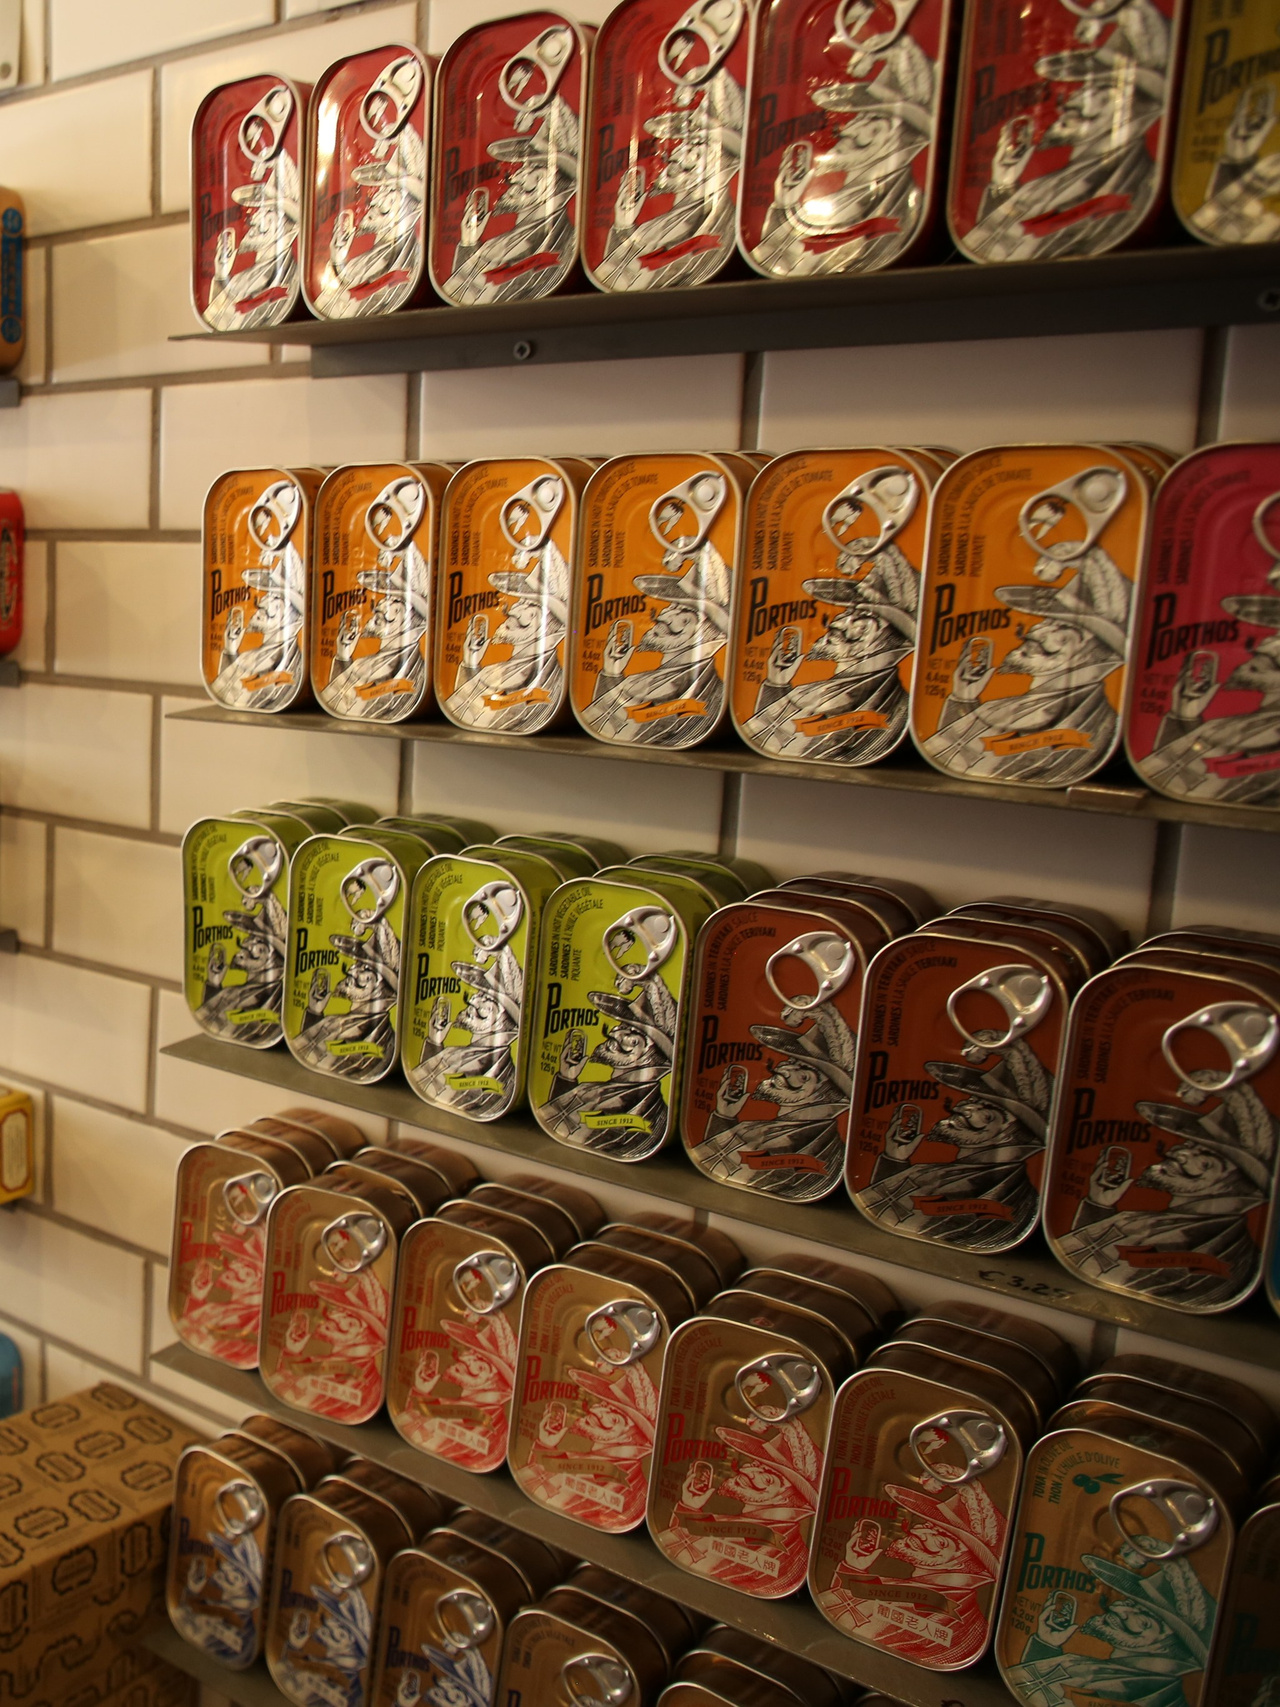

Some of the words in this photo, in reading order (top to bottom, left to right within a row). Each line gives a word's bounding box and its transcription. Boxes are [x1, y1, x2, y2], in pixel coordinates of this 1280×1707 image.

[211, 569, 250, 622] PORTHOS
[323, 570, 366, 626] PORTHOS
[449, 571, 498, 630] PORTHOS
[586, 573, 646, 636] PORTHOS
[748, 576, 817, 644] PORTHOS
[931, 583, 1011, 655] PORTHOS
[1147, 592, 1241, 670] PORTHOS
[192, 906, 233, 953] PORTHOS
[296, 928, 339, 977] PORTHOS
[549, 941, 559, 976] SARDINES
[556, 889, 582, 920] VEGETABLE
[581, 887, 592, 897] OIL
[416, 953, 460, 1005] PORTHOS
[571, 950, 581, 981] PIQUANTE
[544, 983, 599, 1038] PORTHOS
[699, 1016, 763, 1074] PORTHOS
[865, 1051, 940, 1114] PORTHOS
[1067, 1088, 1152, 1155] PORTHOS
[761, 1159, 784, 1167] SINCE
[937, 1205, 964, 1213] SINCE
[271, 1272, 319, 1318] PORTHOS
[401, 1306, 450, 1354] PORTHOS
[524, 1354, 580, 1405] PORTHOS
[664, 1411, 728, 1465] PORTHOS
[1039, 1446, 1061, 1468] OLIVE
[1059, 1439, 1074, 1453] OIL
[558, 1462, 583, 1471] SINCE
[587, 1463, 604, 1472] 1912
[827, 1465, 899, 1522] PORTHOS
[1032, 1474, 1047, 1498] TUNA
[1048, 1481, 1063, 1505] THON
[1085, 1451, 1120, 1468] D'OLIVE
[703, 1525, 733, 1534] SINCE
[737, 1526, 757, 1535] 1912
[1017, 1533, 1096, 1594] PORTHOS
[868, 1589, 901, 1598] SINCE
[906, 1591, 928, 1600] 1912
